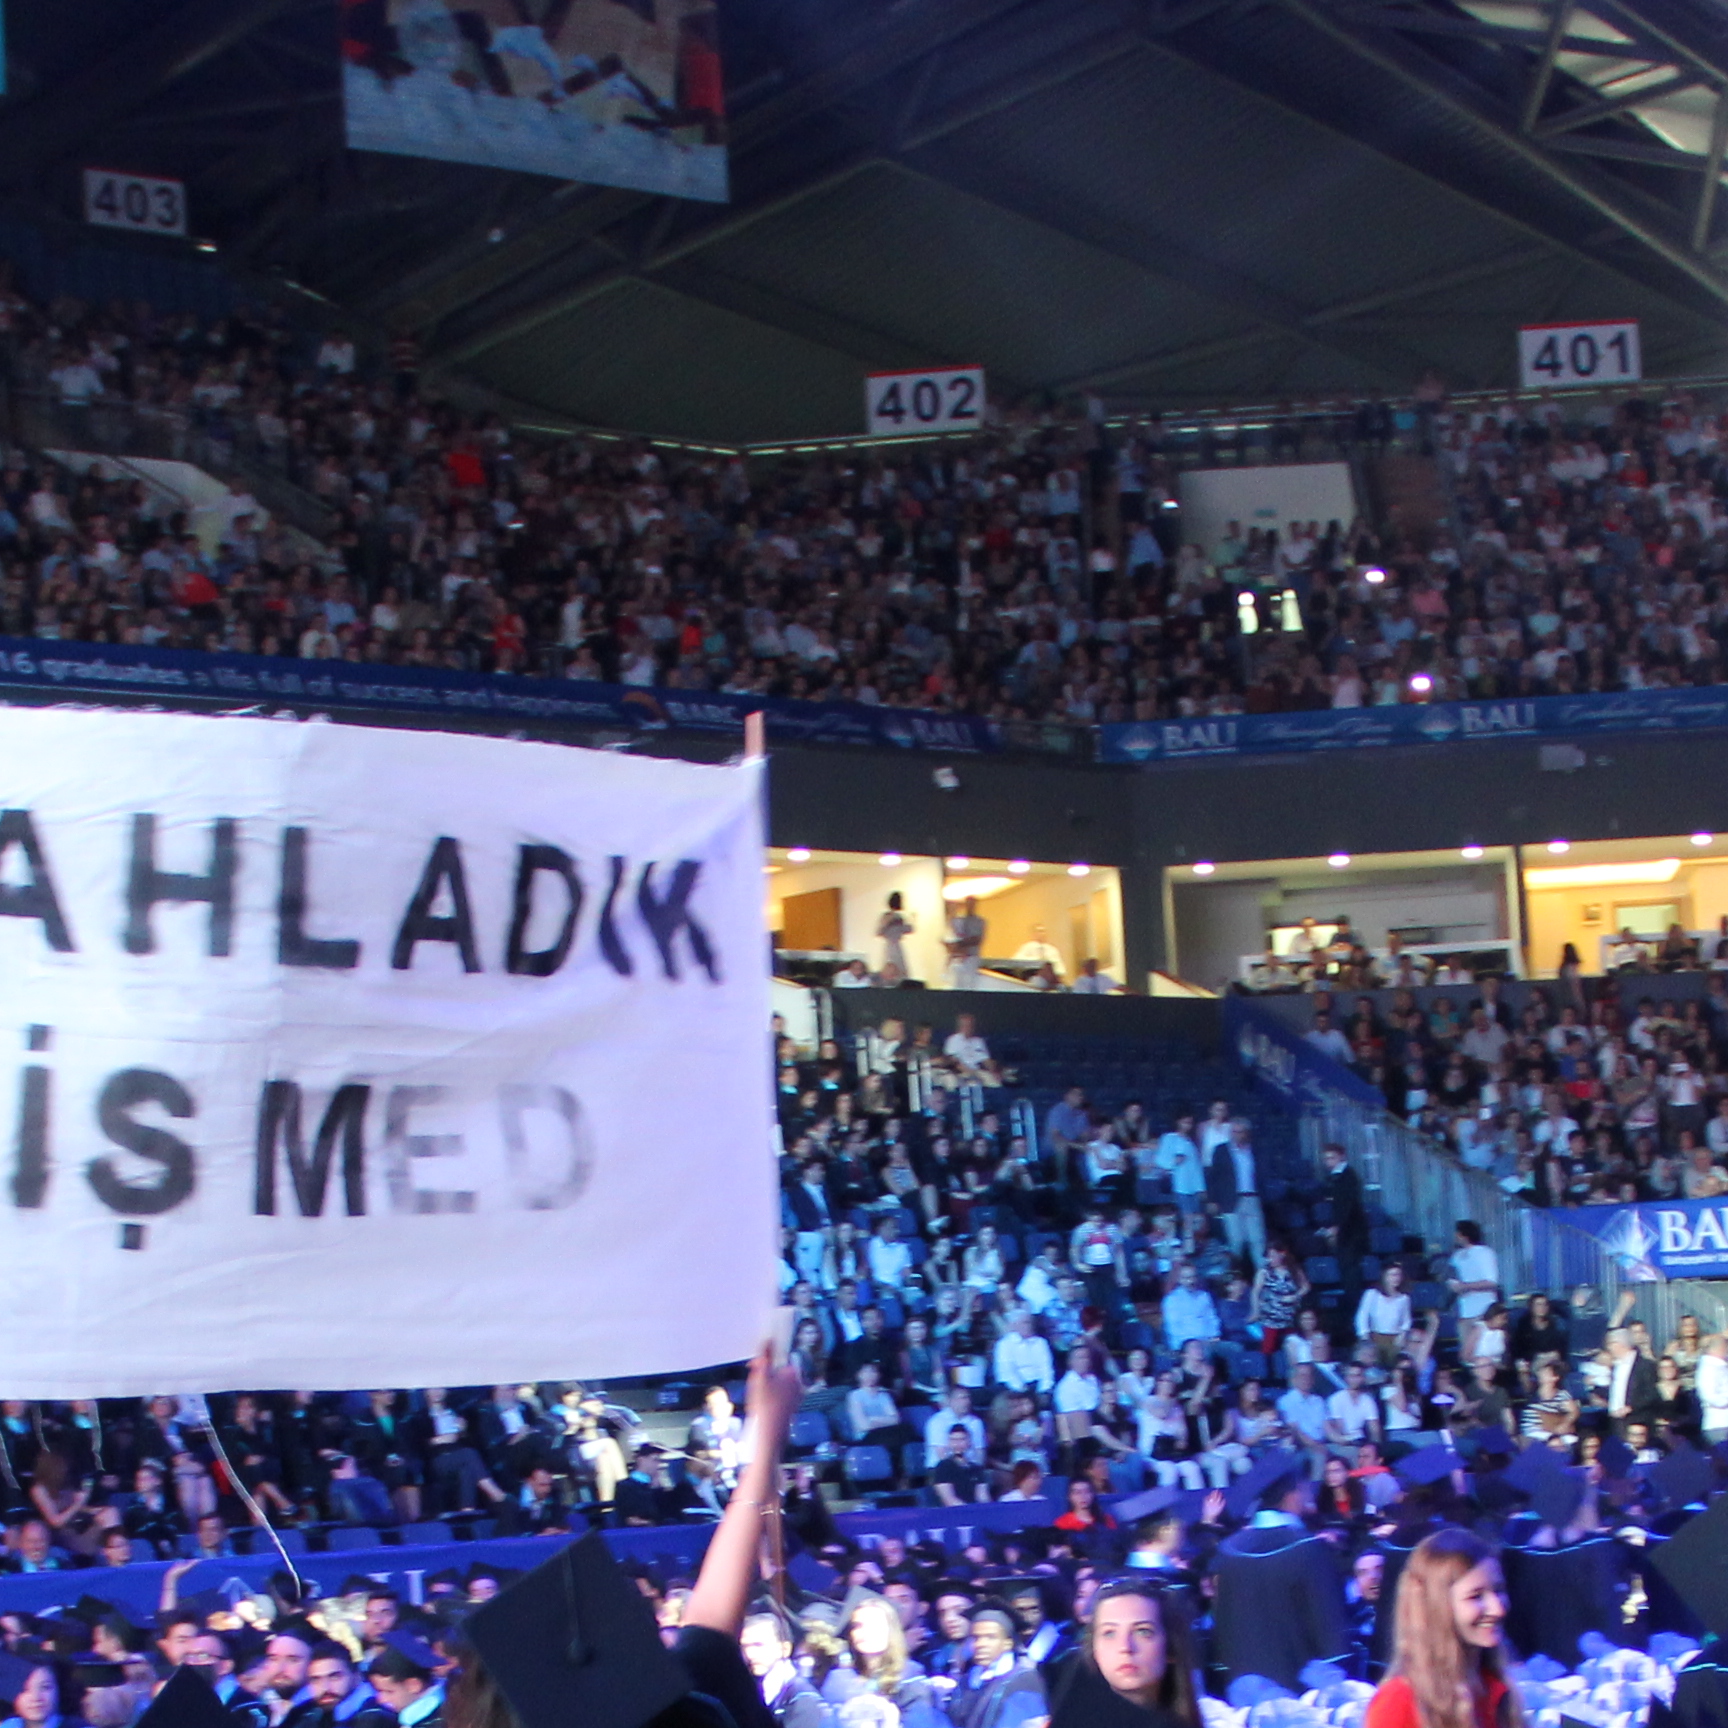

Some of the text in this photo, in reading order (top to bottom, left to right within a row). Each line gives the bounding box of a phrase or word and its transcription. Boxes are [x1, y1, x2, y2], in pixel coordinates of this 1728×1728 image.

[93, 178, 178, 229] 403
[1532, 330, 1630, 378] 401
[876, 376, 976, 424] 402
[1161, 721, 1237, 751] BAU
[1461, 703, 1536, 733] BAU
